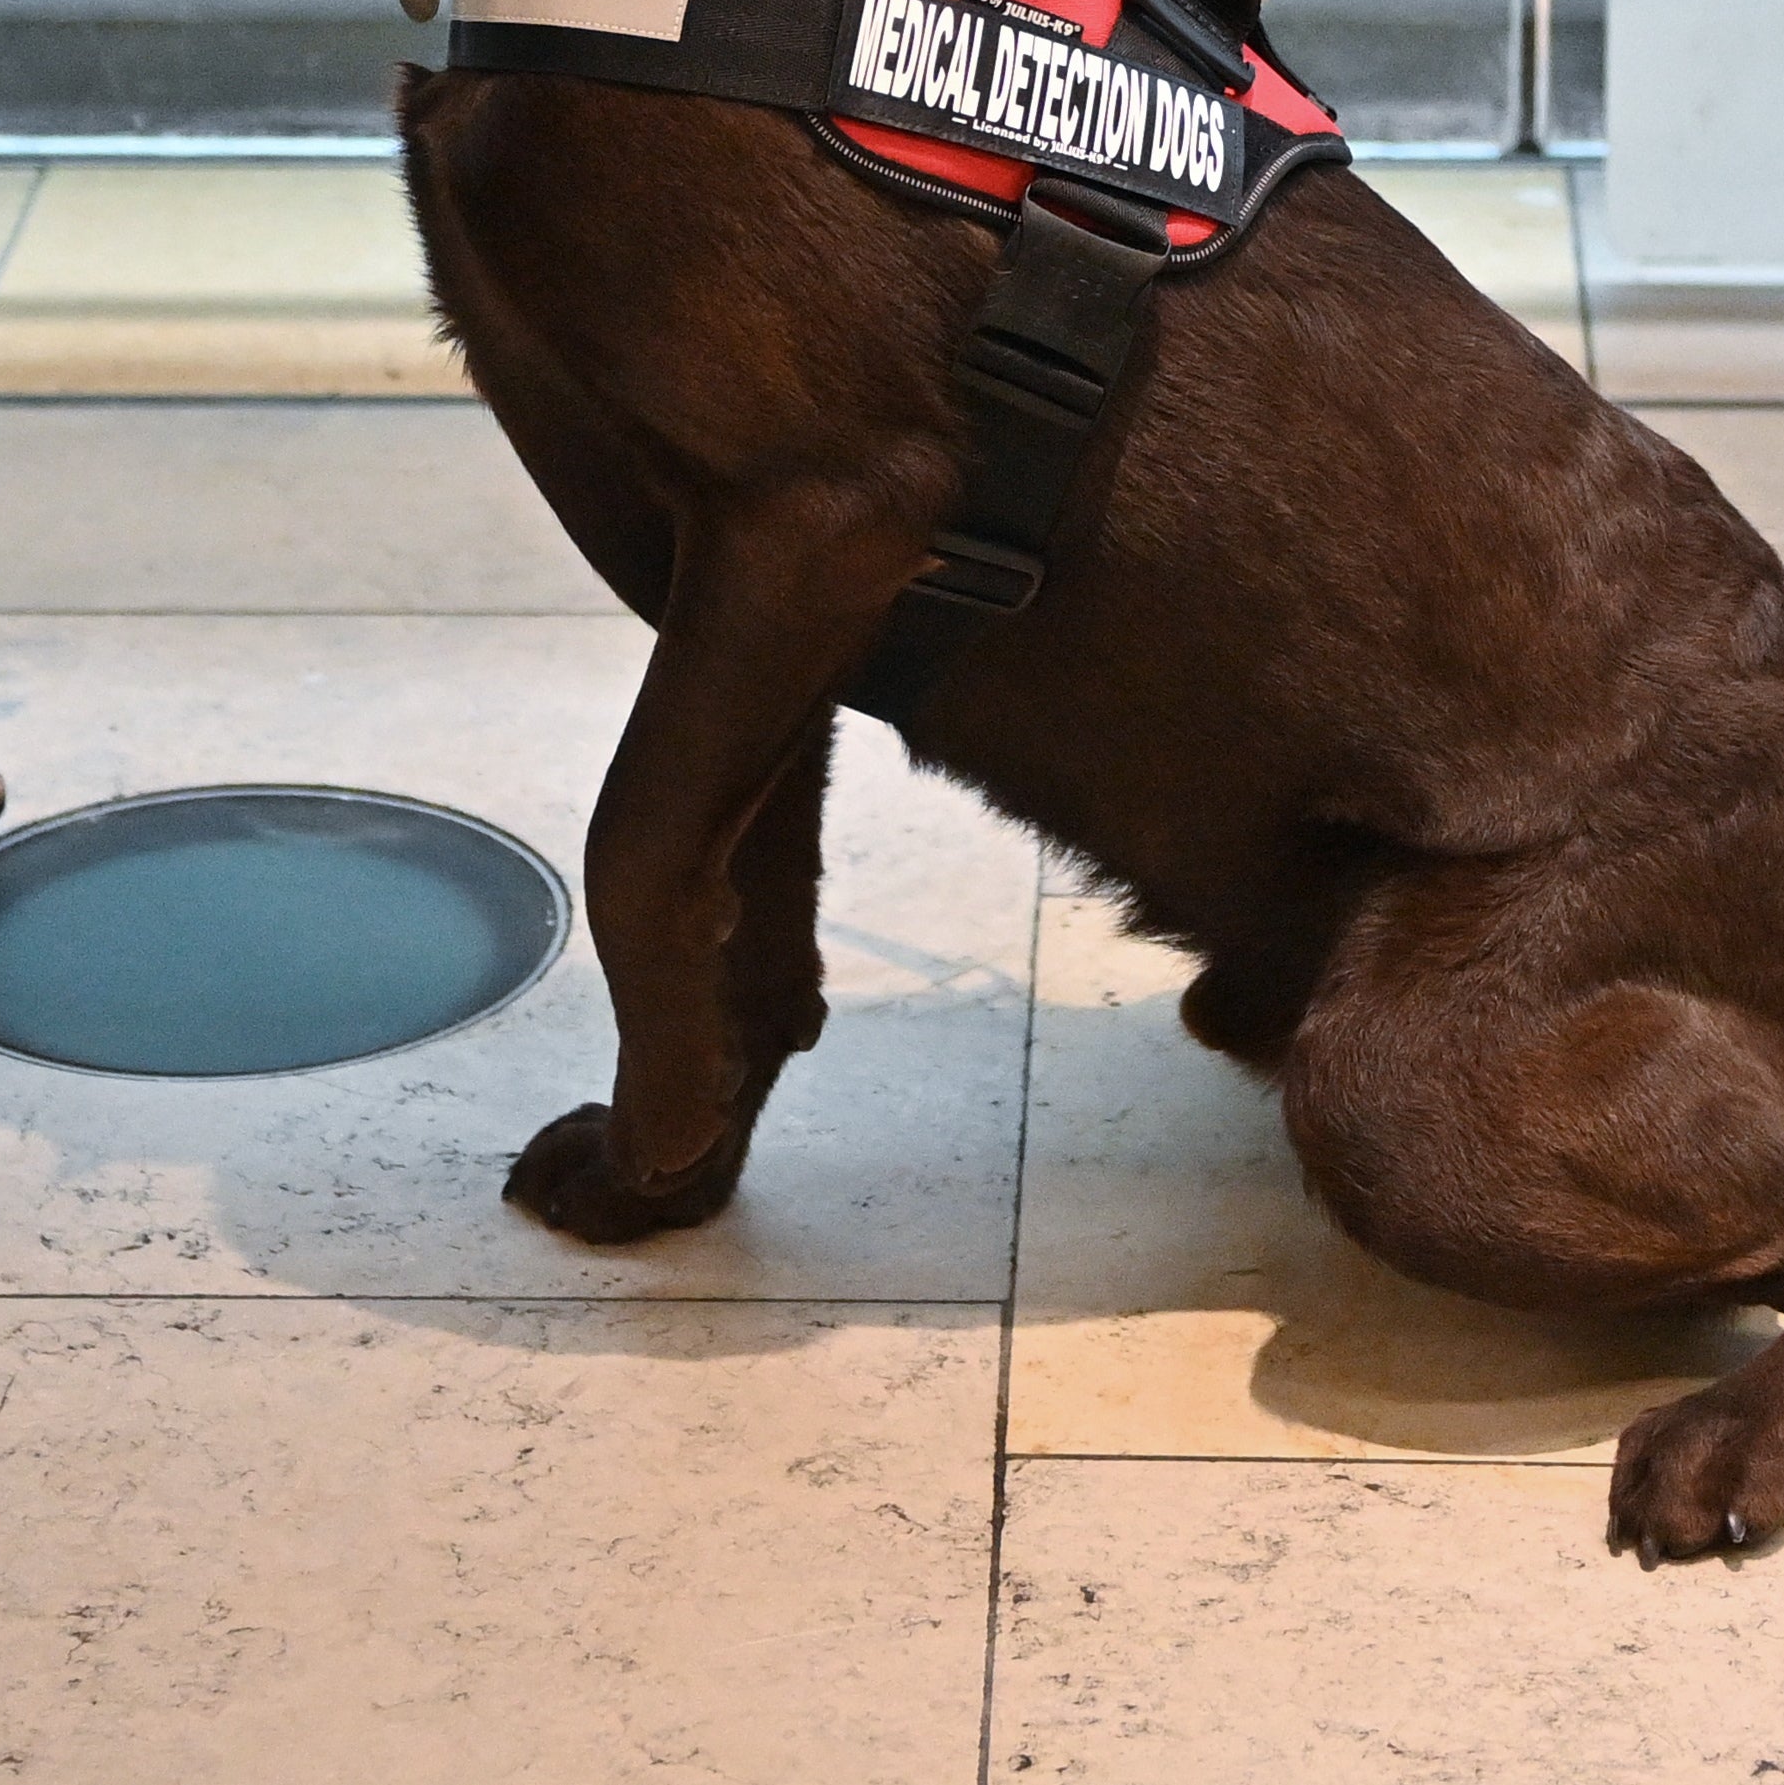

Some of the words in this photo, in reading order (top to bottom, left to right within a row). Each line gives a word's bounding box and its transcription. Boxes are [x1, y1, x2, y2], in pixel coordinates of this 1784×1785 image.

[972, 118, 1031, 145] Licensed
[1032, 136, 1049, 152] by
[985, 25, 1150, 166] DETECTION
[1149, 77, 1226, 193] DOGS
